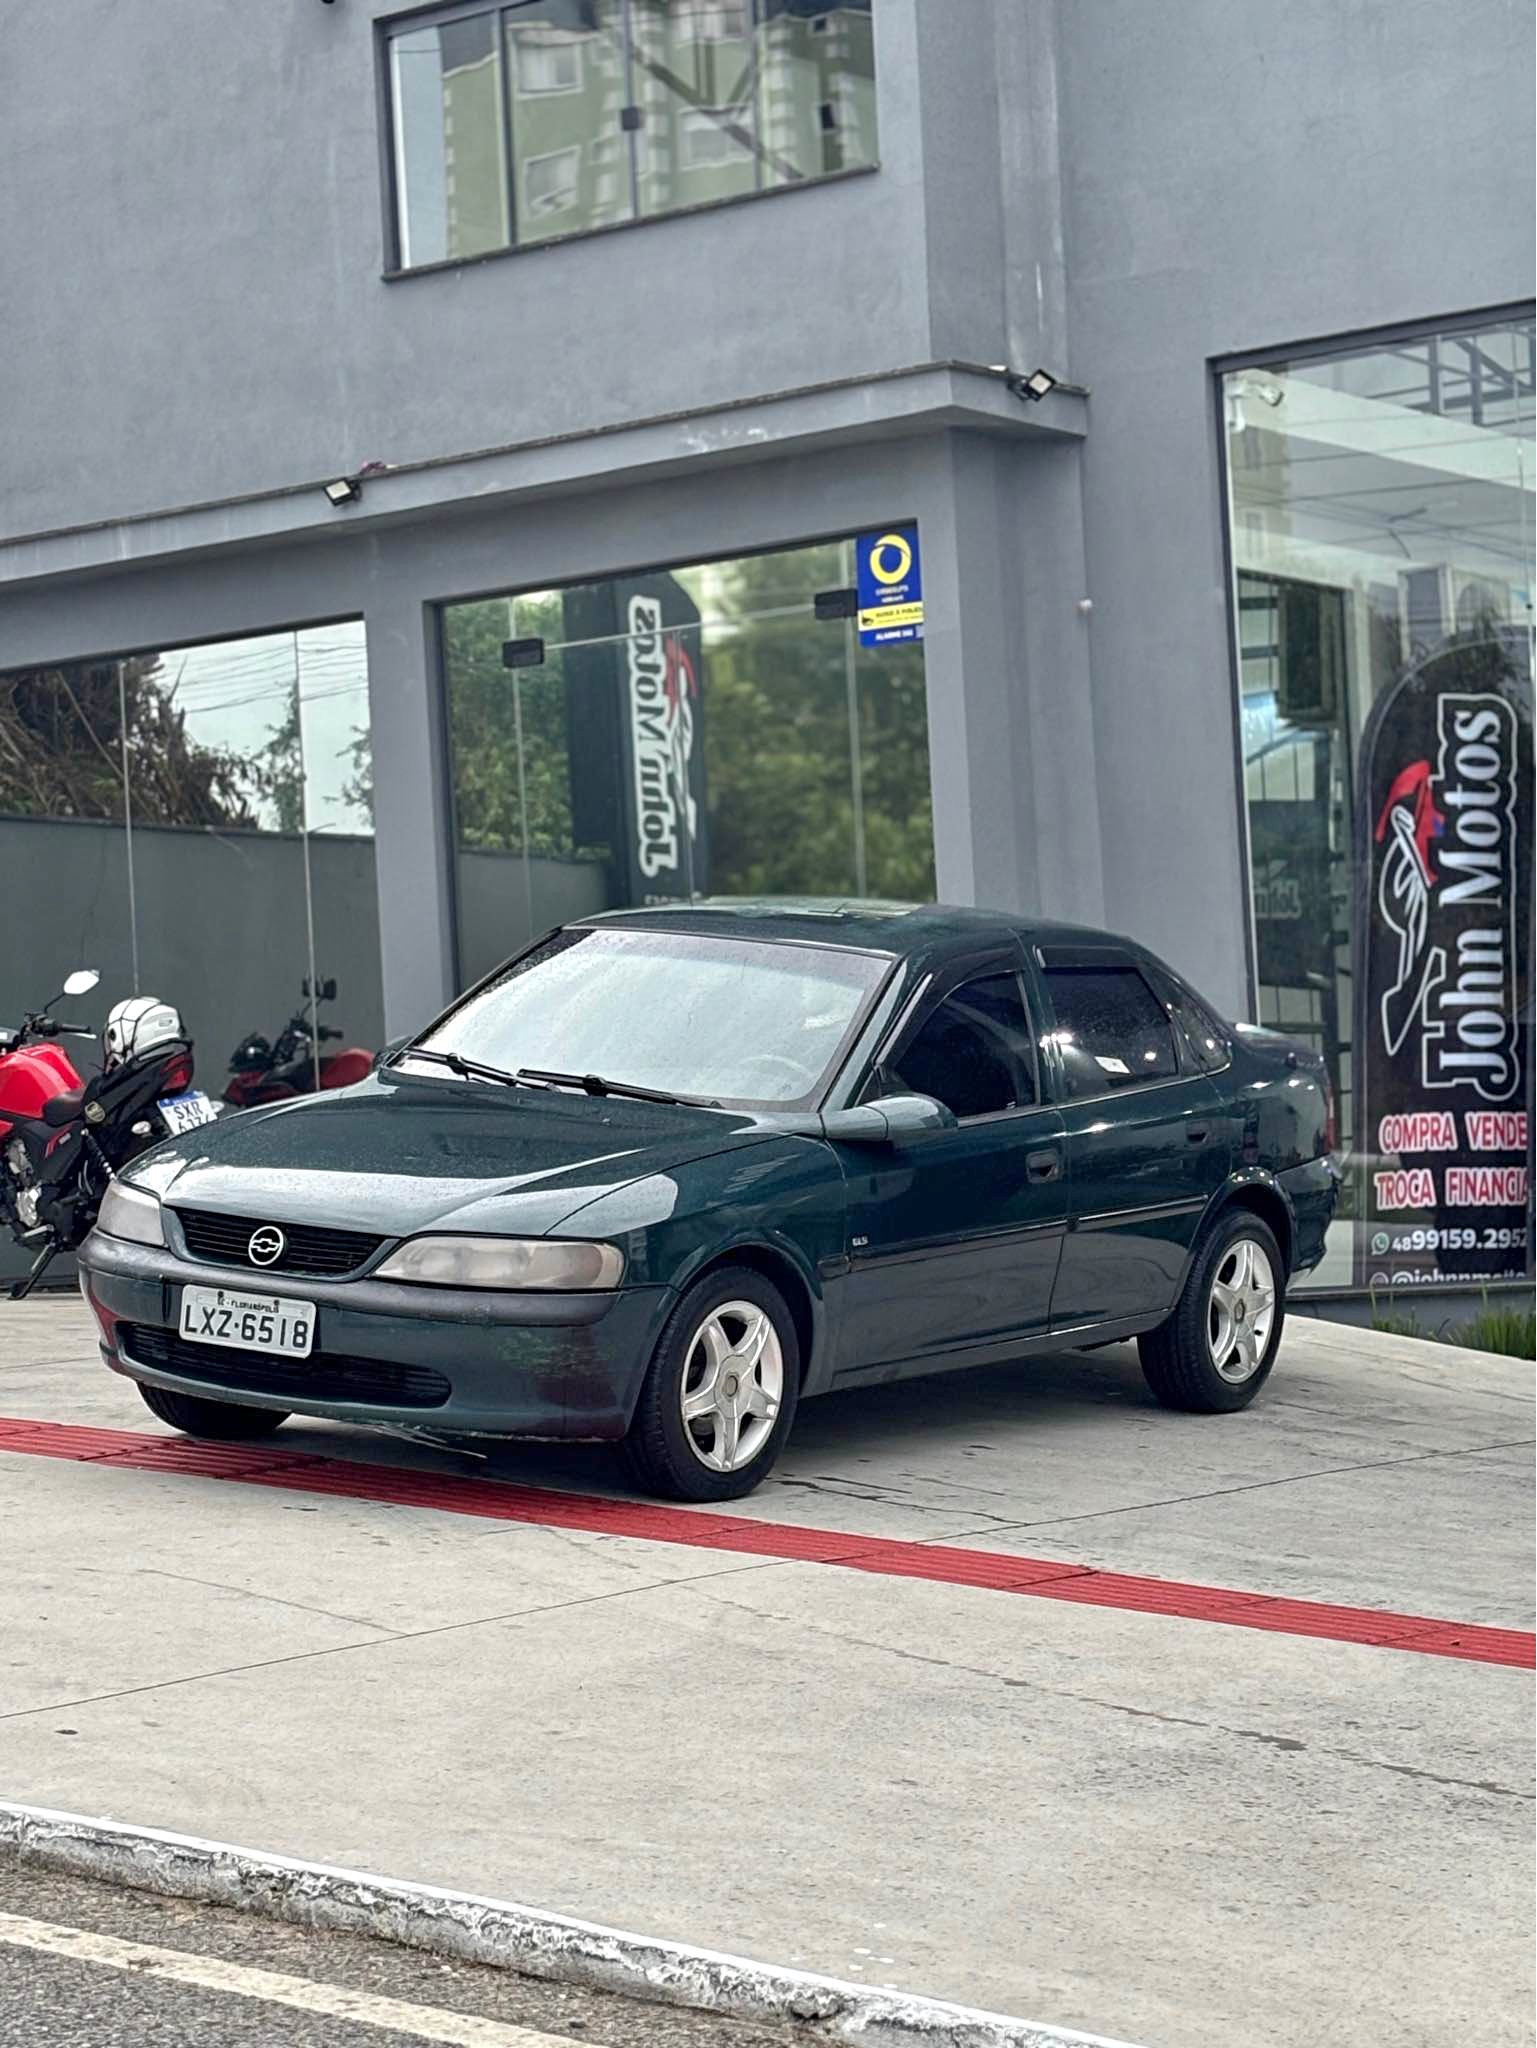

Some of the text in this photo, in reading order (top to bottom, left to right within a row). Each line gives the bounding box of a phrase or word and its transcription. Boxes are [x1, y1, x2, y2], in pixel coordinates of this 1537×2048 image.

[1438, 709, 1507, 1085] John Motos
[1379, 1111, 1527, 1152] COMPRA VENDE
[1375, 1169, 1436, 1210] TROCA
